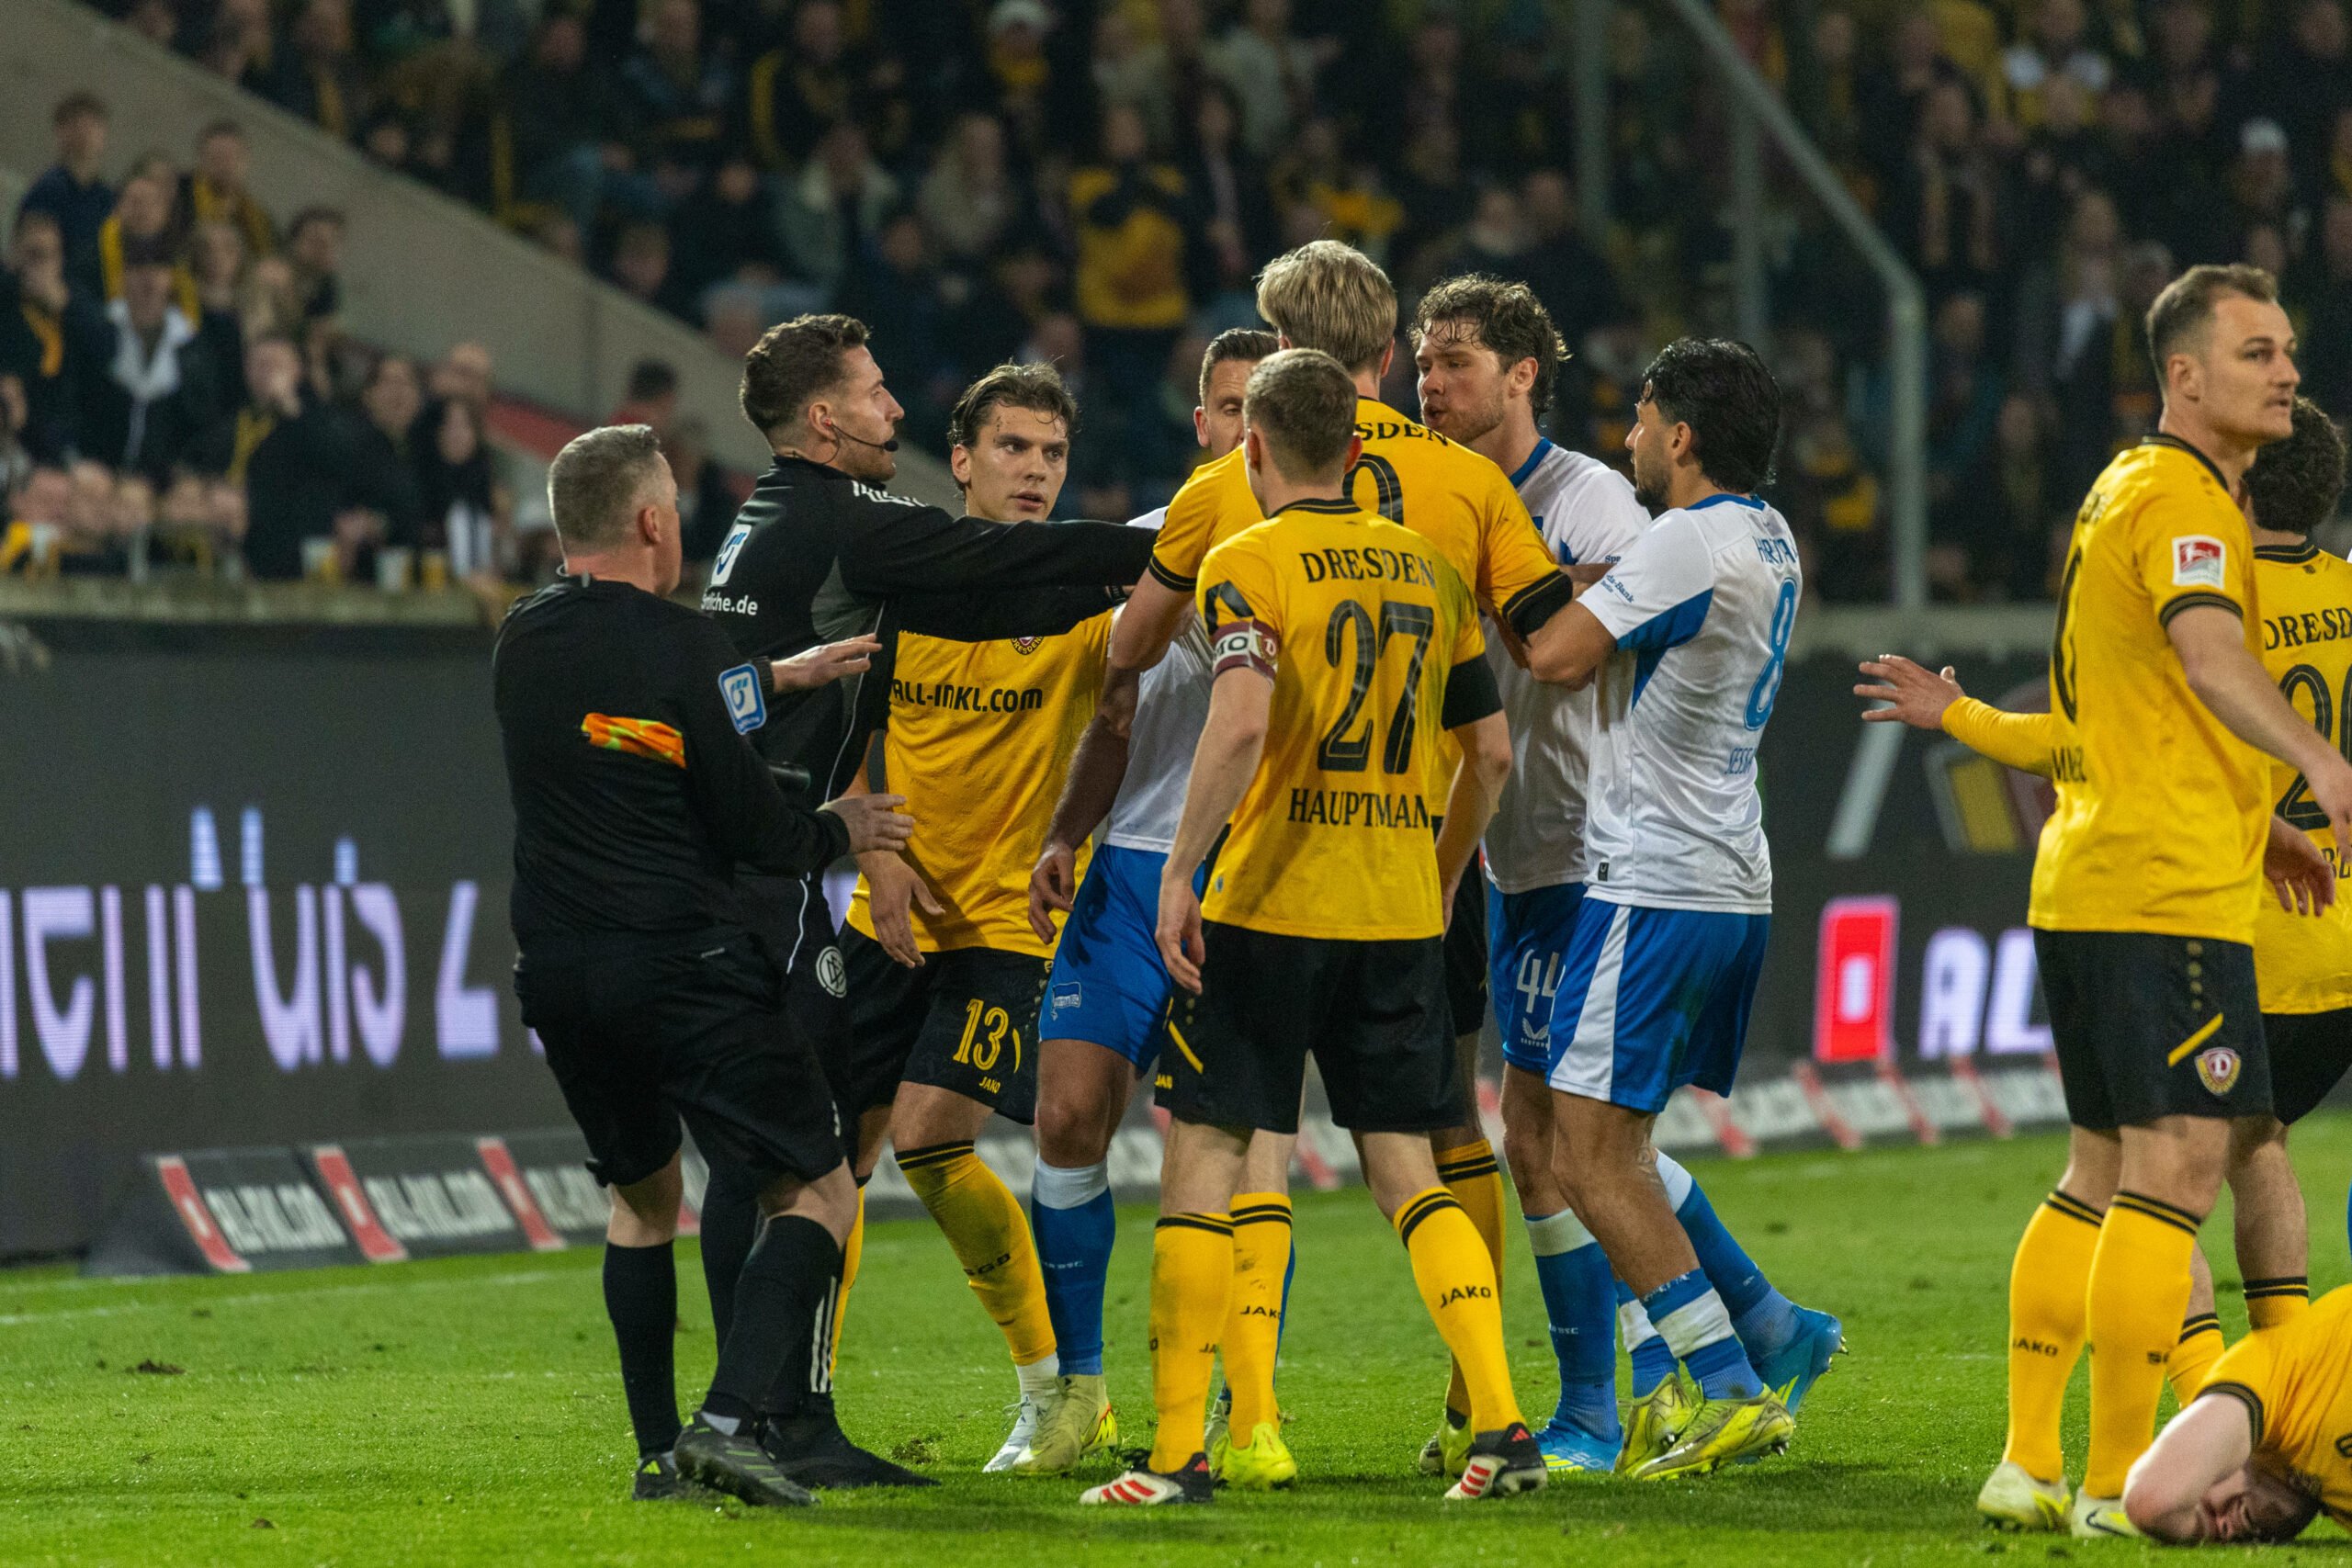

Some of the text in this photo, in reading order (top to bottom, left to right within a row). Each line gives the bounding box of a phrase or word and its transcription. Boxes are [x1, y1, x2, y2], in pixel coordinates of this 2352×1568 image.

[1299, 547, 1436, 590] DRESDEN
[1743, 576, 1798, 731] 8
[1317, 599, 1434, 774] 27
[953, 998, 1009, 1071] 13
[978, 1076, 1001, 1094] JAKO
[1441, 1286, 1491, 1309] JAKO
